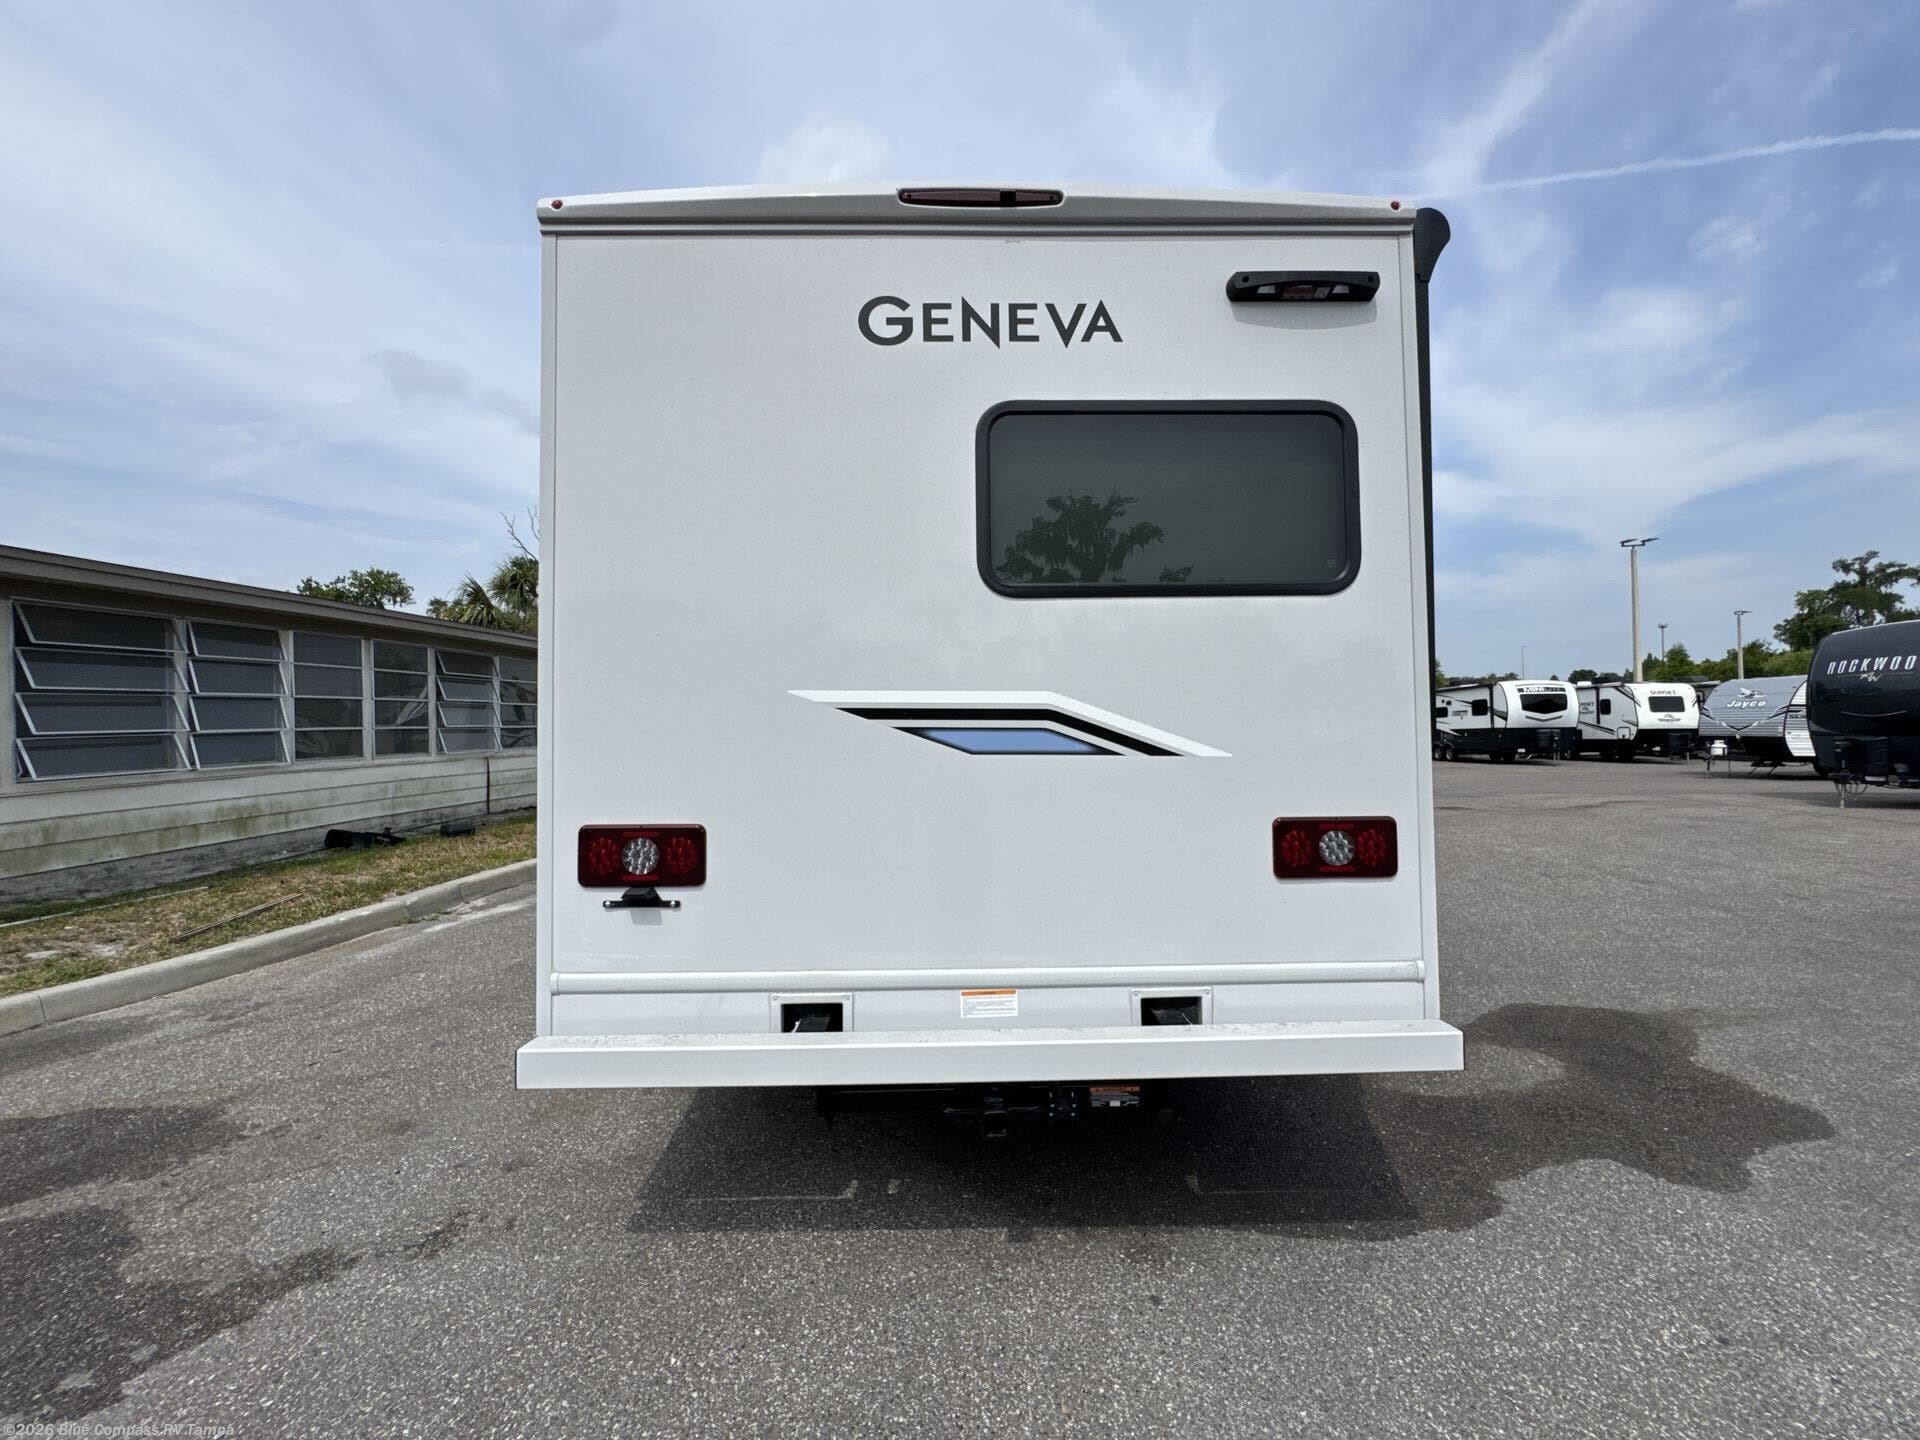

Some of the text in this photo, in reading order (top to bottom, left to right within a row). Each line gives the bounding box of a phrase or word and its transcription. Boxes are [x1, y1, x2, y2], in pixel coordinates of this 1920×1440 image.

[858, 295, 1123, 349] GENEVA
[1826, 655, 1918, 675] ROCKWOO
[1726, 700, 1767, 709] Jayco
